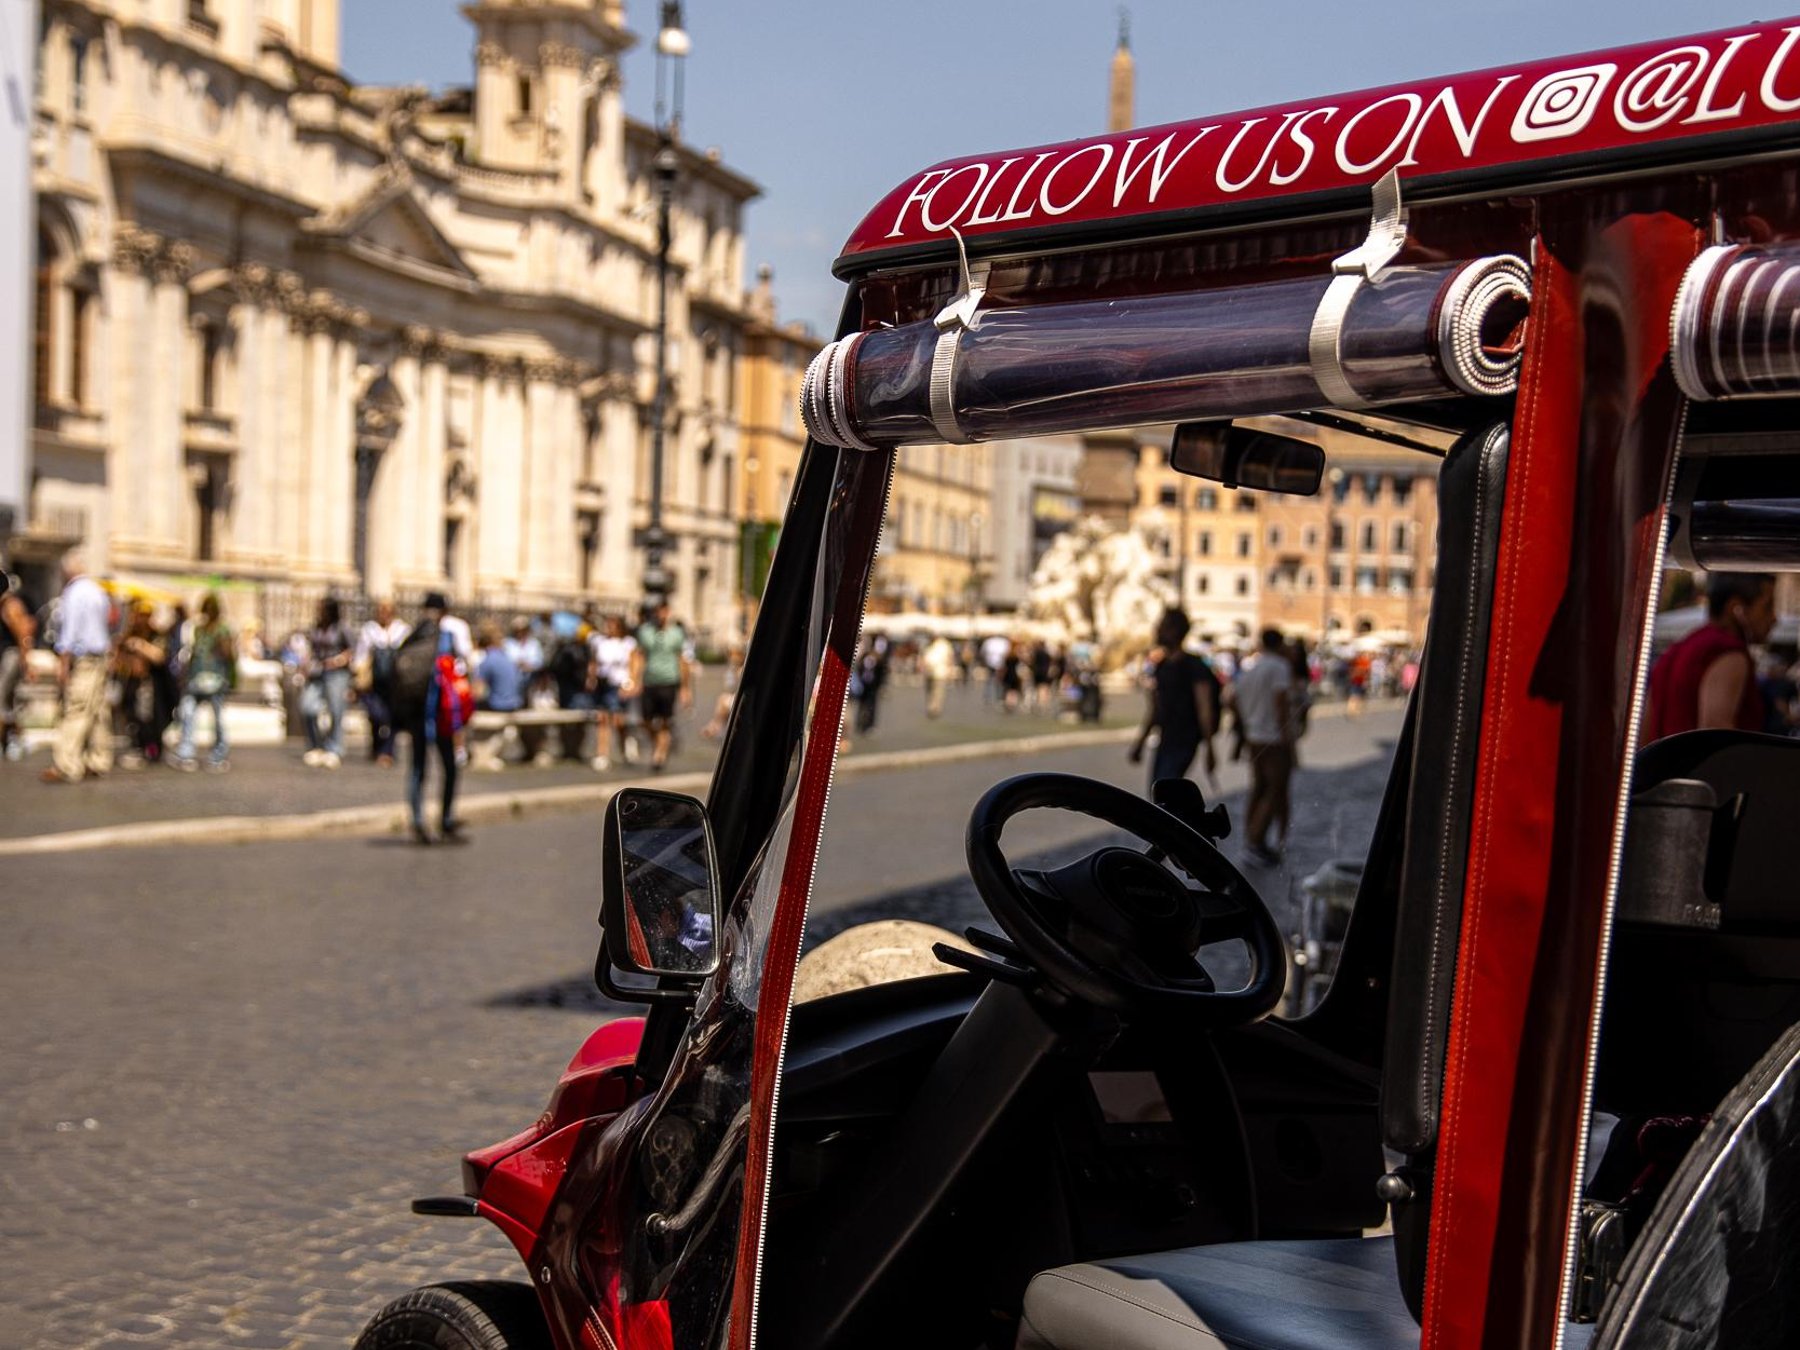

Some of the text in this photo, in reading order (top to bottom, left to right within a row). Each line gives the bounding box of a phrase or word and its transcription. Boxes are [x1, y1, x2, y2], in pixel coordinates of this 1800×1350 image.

[885, 124, 1222, 238] FOLLOW
[1215, 106, 1340, 193] US
[1334, 74, 1522, 175] ON
